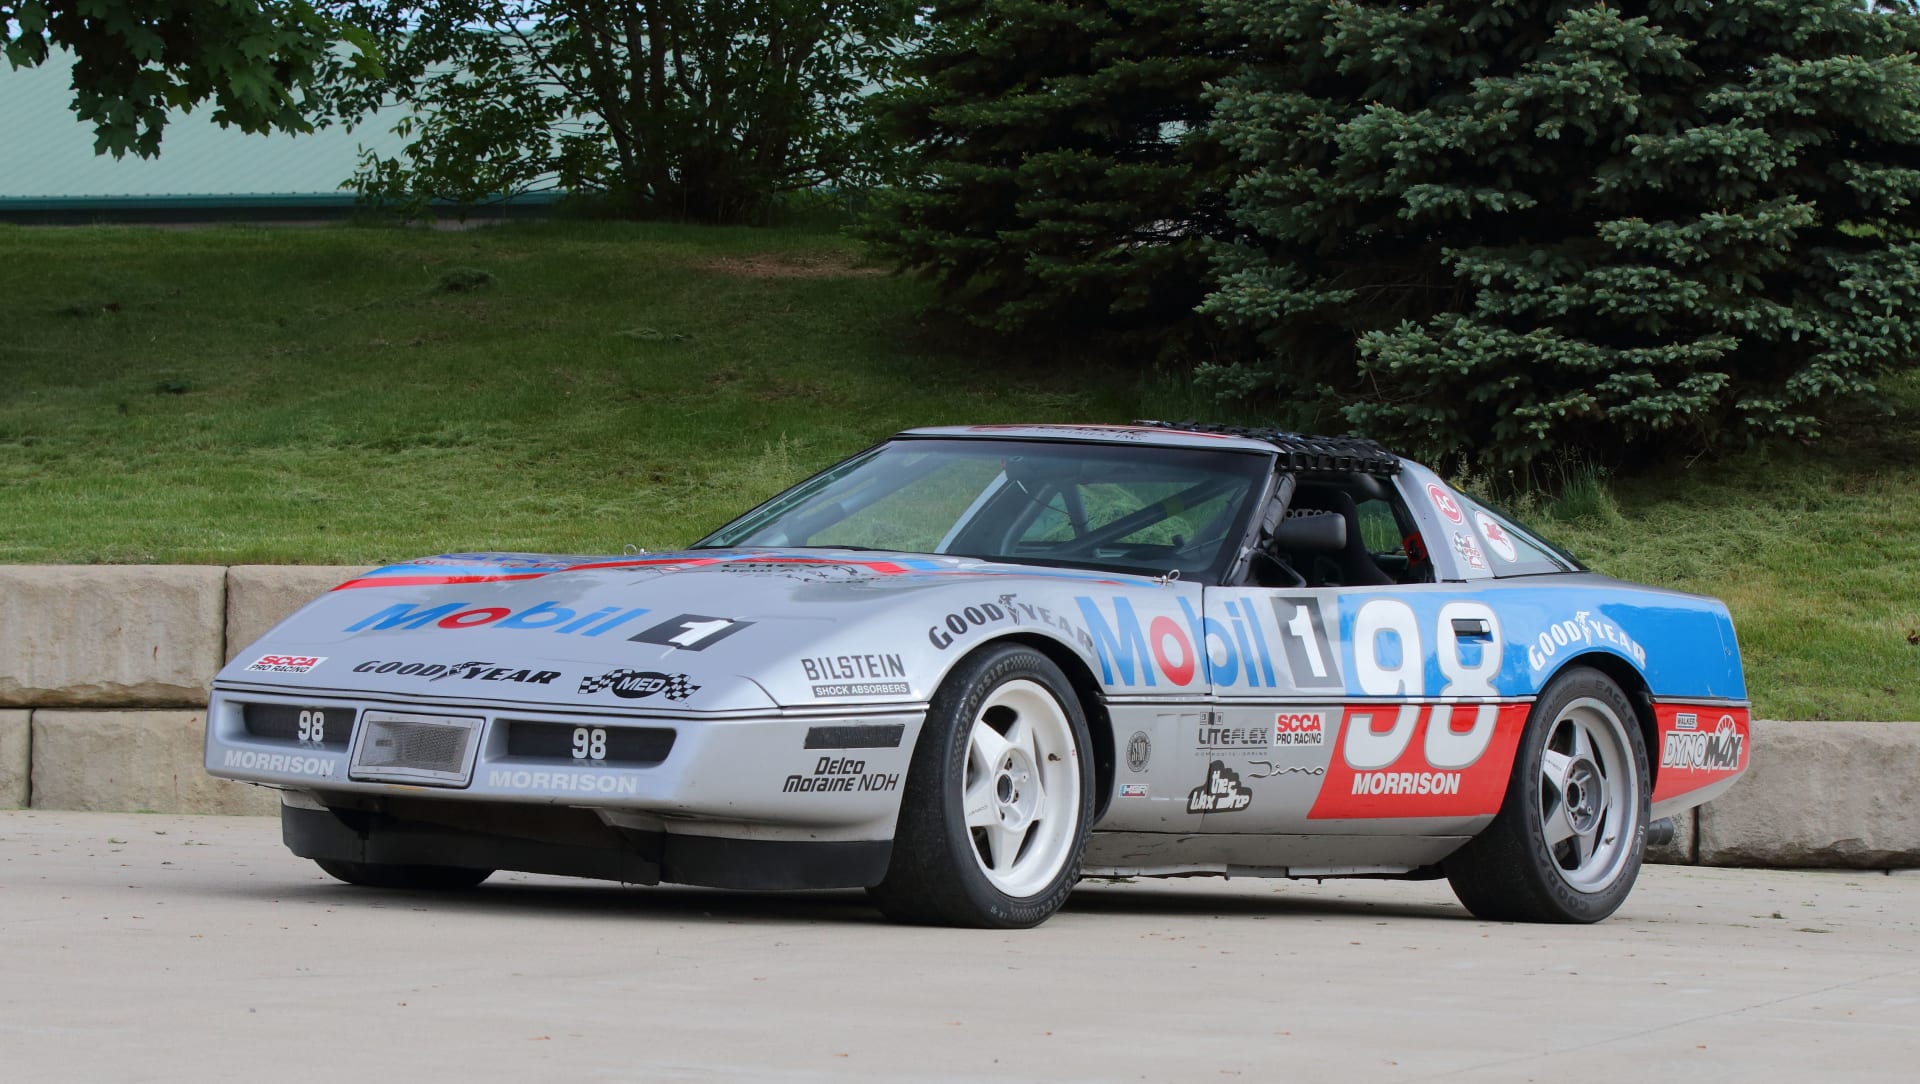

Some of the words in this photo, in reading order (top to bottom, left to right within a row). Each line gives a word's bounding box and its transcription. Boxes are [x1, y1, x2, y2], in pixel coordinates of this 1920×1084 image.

[1435, 494, 1457, 513] AC
[343, 601, 651, 638] Mobil
[668, 619, 735, 647] 1
[1075, 595, 1277, 688] Mobil
[1289, 604, 1328, 678] 1
[258, 655, 319, 667] SCCA
[270, 665, 310, 673] RACING
[800, 653, 906, 681] BILSTEIN
[616, 677, 668, 692] MED
[815, 687, 850, 696] SHOCK
[851, 683, 907, 694] ABSORBERS
[1343, 597, 1503, 771] 98
[297, 710, 326, 743] 98
[1276, 713, 1322, 733] SCCA
[571, 727, 607, 761] 98
[1276, 733, 1292, 745] PRO
[1293, 732, 1322, 744] RACING
[1661, 730, 1743, 770] DYNOMAX
[224, 749, 335, 777] MORRISON
[814, 757, 866, 775] Delco
[488, 770, 638, 794] MORRISON
[783, 774, 856, 793] Moraine
[857, 773, 900, 792] NDH
[1351, 773, 1461, 795] MORRISON
